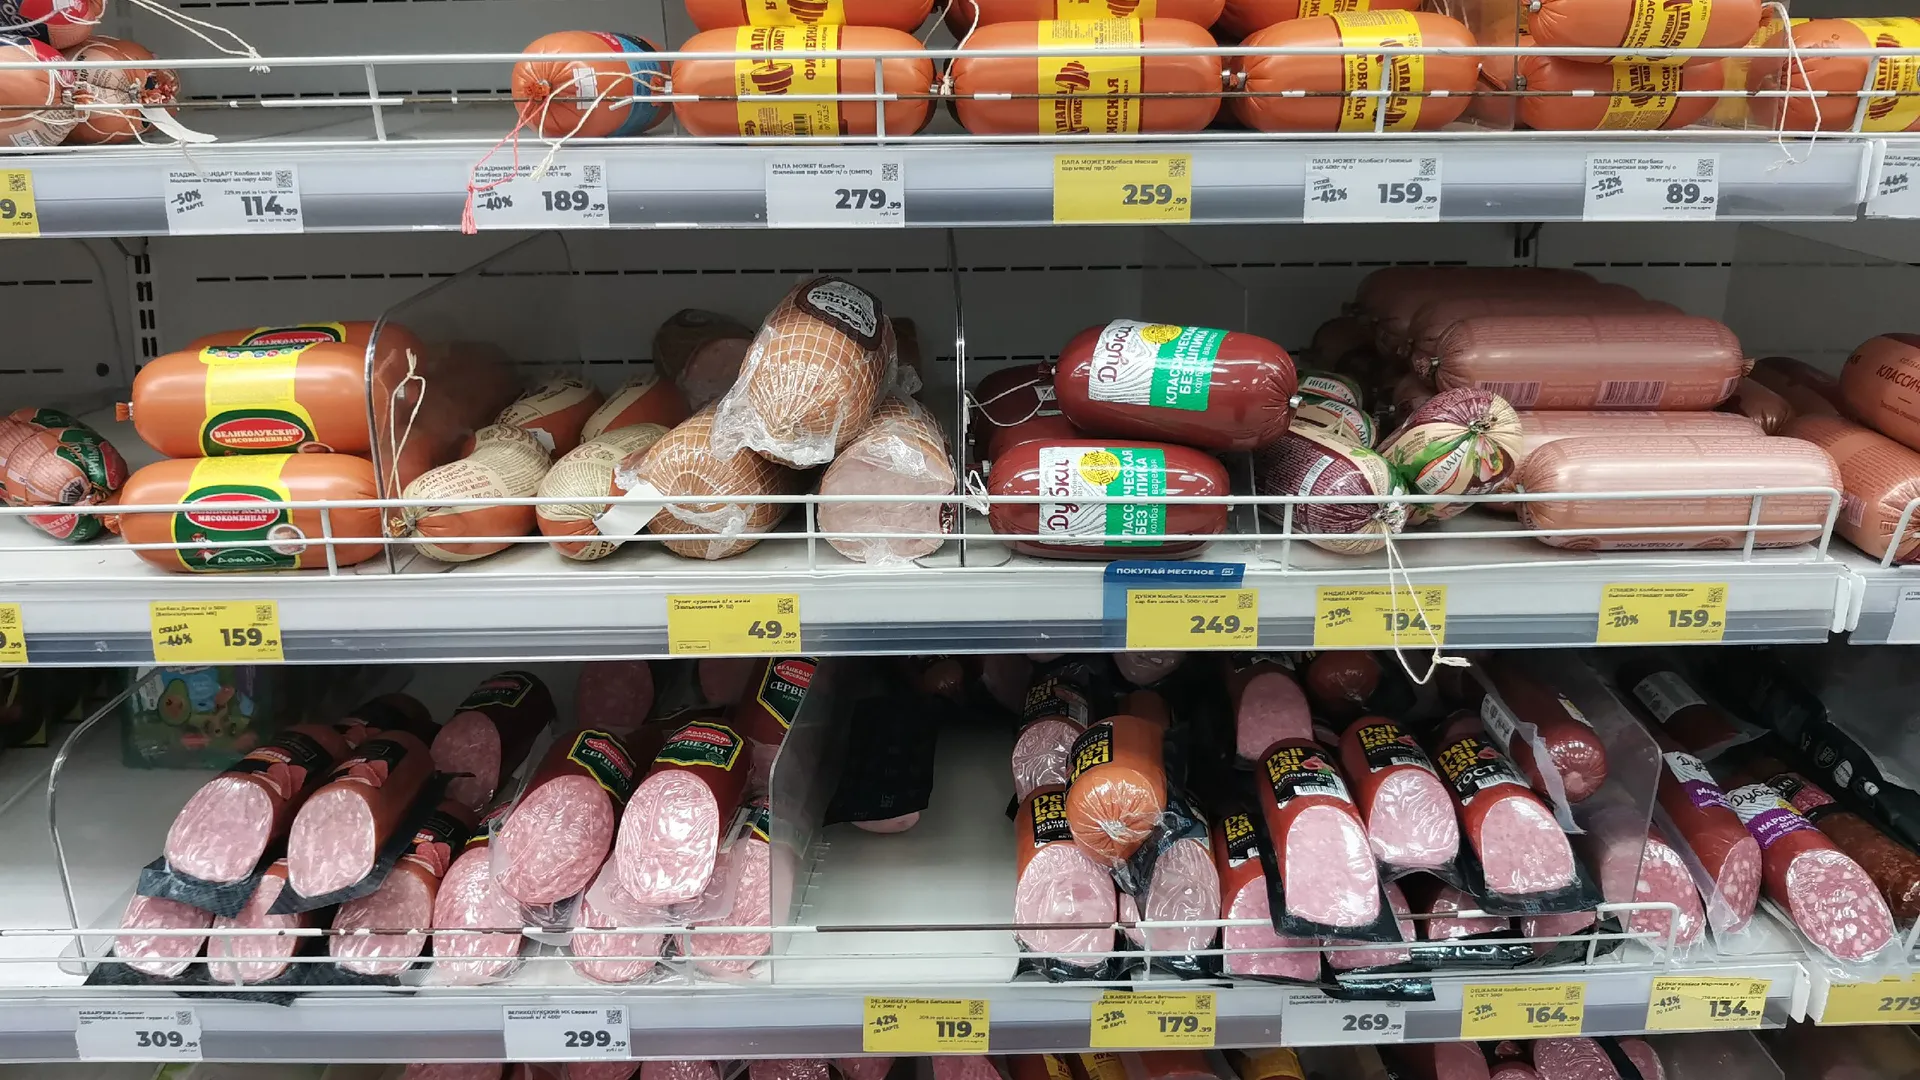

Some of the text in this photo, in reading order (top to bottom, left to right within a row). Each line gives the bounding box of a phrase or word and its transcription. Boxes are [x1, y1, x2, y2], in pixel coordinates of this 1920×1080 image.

[1660, 14, 1675, 44] МОЖЕТ
[1670, 11, 1691, 47] ПАПА
[1073, 98, 1082, 125] МОЖЕ
[1180, 330, 1209, 395] БЕЗ ШПИКА
[214, 427, 300, 439] ВЕЛИКОЛУКСКИЙ
[1135, 510, 1148, 535] БЕЗ
[1116, 567, 1165, 575] ПОКУПАЙ
[769, 680, 808, 698] СЕРВЕ
[1455, 764, 1497, 792] ГОСТ
[1731, 788, 1775, 807] Дубк
